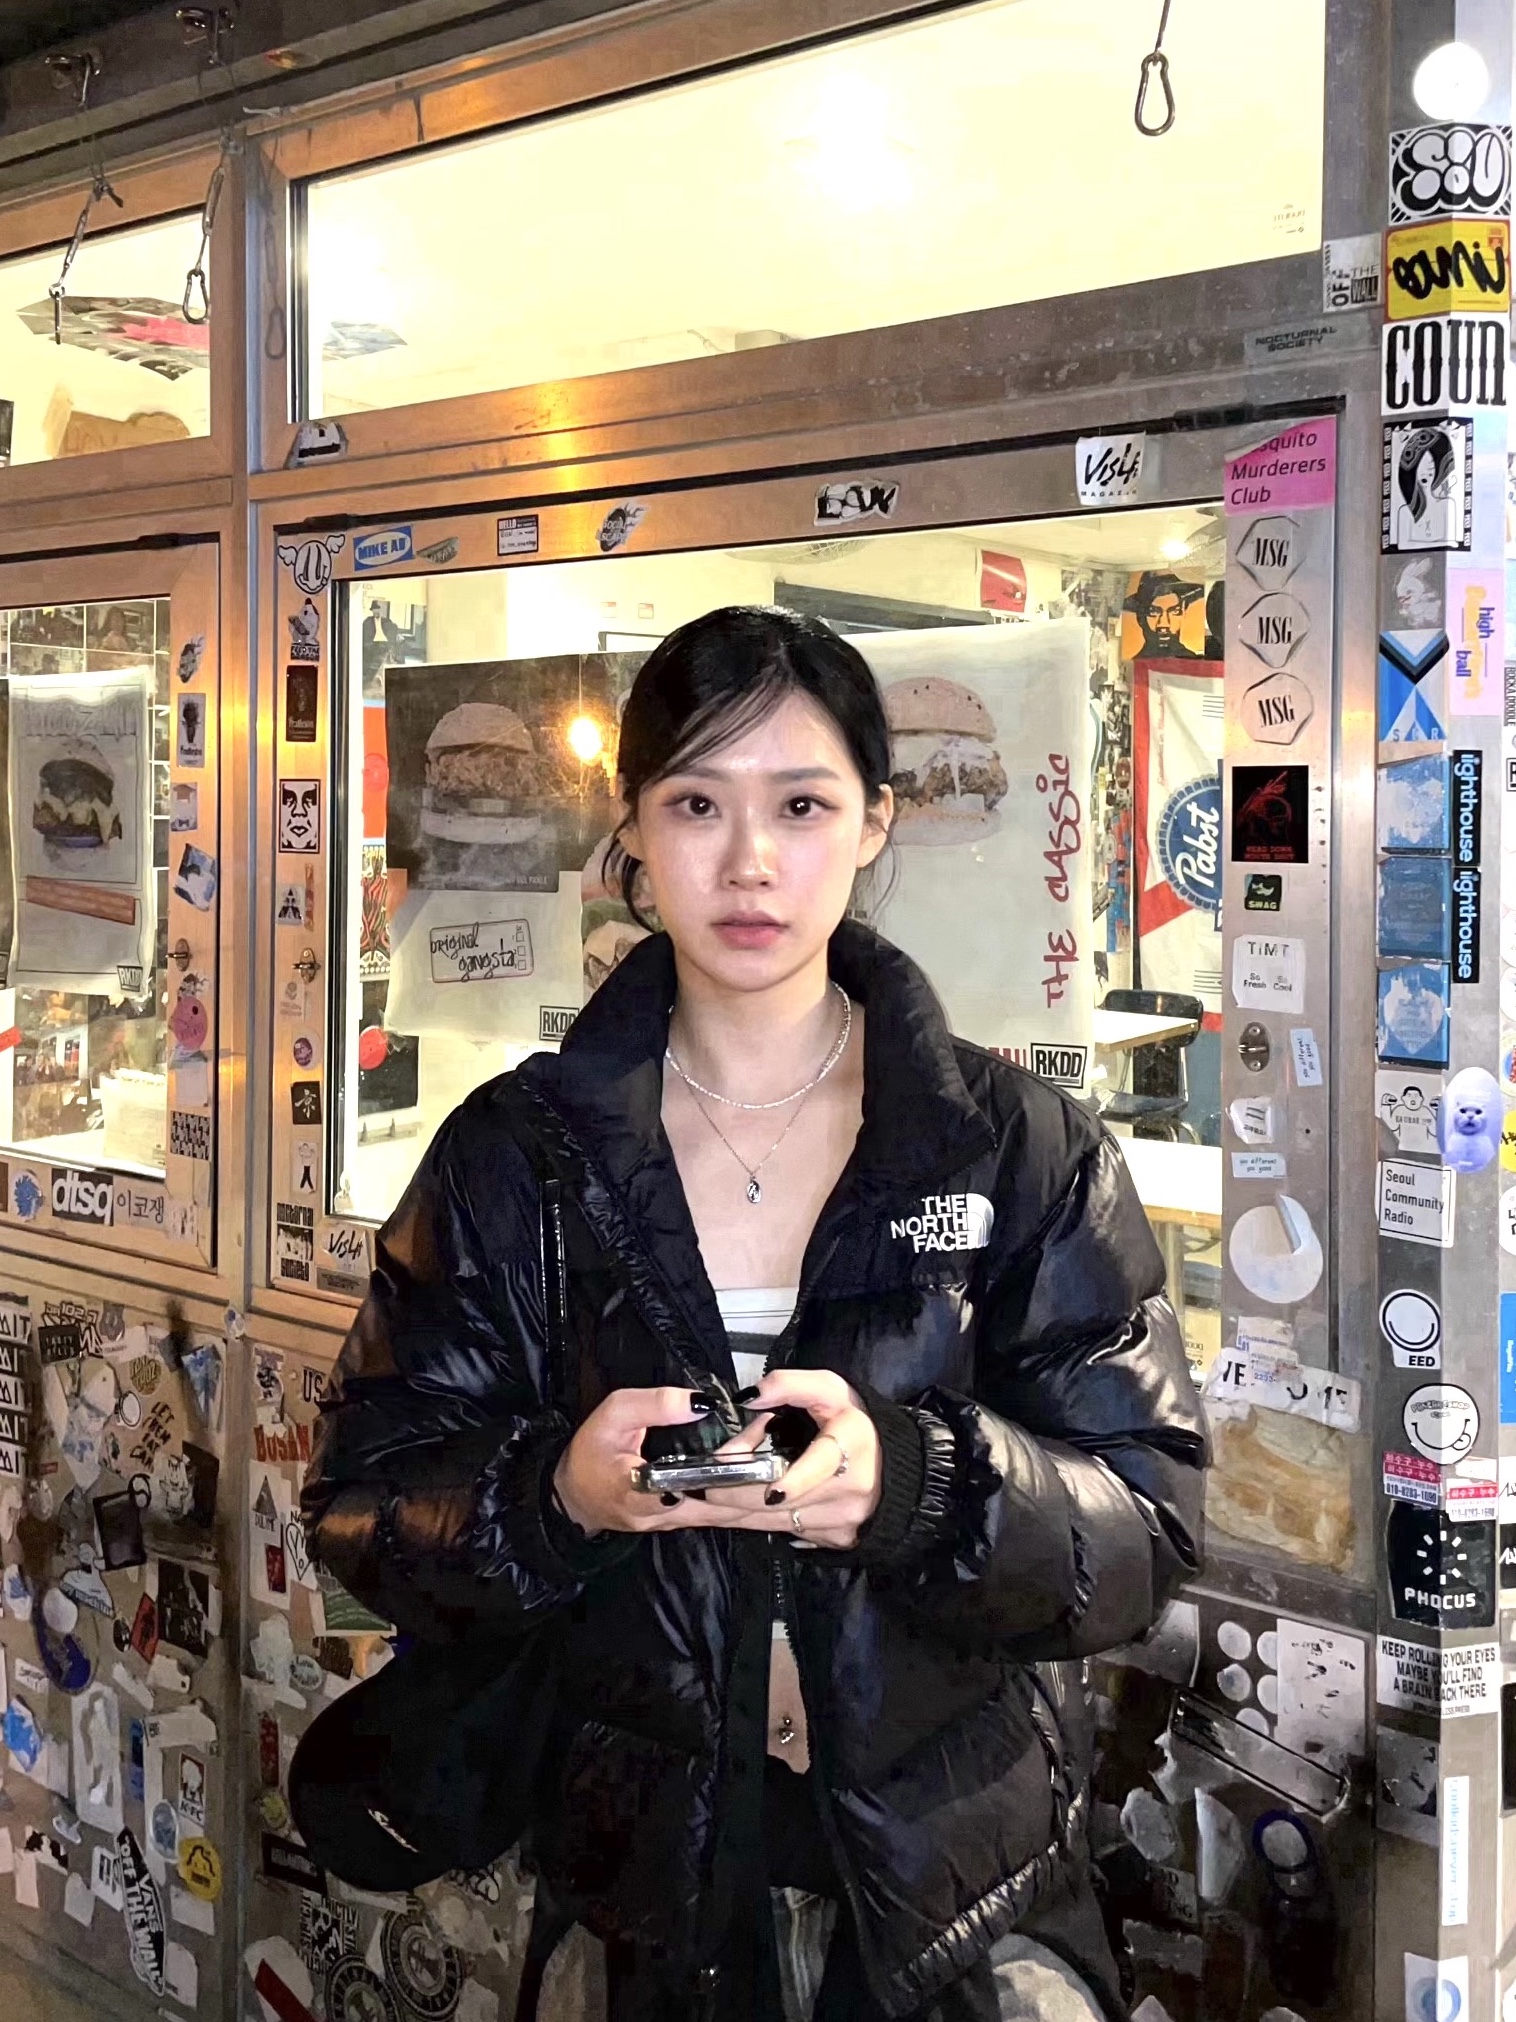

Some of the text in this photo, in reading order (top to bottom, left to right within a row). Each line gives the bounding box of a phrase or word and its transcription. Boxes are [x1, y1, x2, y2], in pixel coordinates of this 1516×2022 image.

[1351, 264, 1379, 277] THE
[1351, 275, 1379, 303] WALL
[1231, 455, 1326, 481] Murderers
[1231, 486, 1271, 505] Club
[357, 541, 388, 559] MIKE
[1252, 536, 1290, 568] MSG
[1256, 616, 1292, 645] MSG
[1477, 606, 1495, 639] high
[1456, 650, 1472, 677] ball
[1258, 694, 1295, 727] MSG
[1452, 753, 1480, 863] lighthouse
[1174, 800, 1221, 889] Pabst
[1248, 900, 1277, 910] SWAG
[1453, 870, 1480, 980] lighthouse
[1041, 928, 1079, 1009] THE
[1035, 1049, 1083, 1077] RKDD
[1385, 1169, 1416, 1186] Seoul
[52, 1169, 113, 1226] dtsq
[923, 1194, 967, 1215] THE
[1384, 1188, 1445, 1214] Community
[890, 1214, 968, 1239] NORTH
[1383, 1208, 1414, 1226] Radio
[913, 1231, 968, 1253] FACE
[1408, 1355, 1436, 1367] EED
[1404, 1587, 1477, 1610] PHOCUS
[1381, 1640, 1407, 1658] KEEP
[1450, 1650, 1472, 1666] YOUR
[1474, 1647, 1496, 1663] EYES
[1396, 1660, 1429, 1682] MAYBE
[1462, 1666, 1483, 1681] FIND
[1393, 1677, 1400, 1692] A
[1401, 1679, 1433, 1701] BRAIN
[1458, 1683, 1487, 1700] THERE
